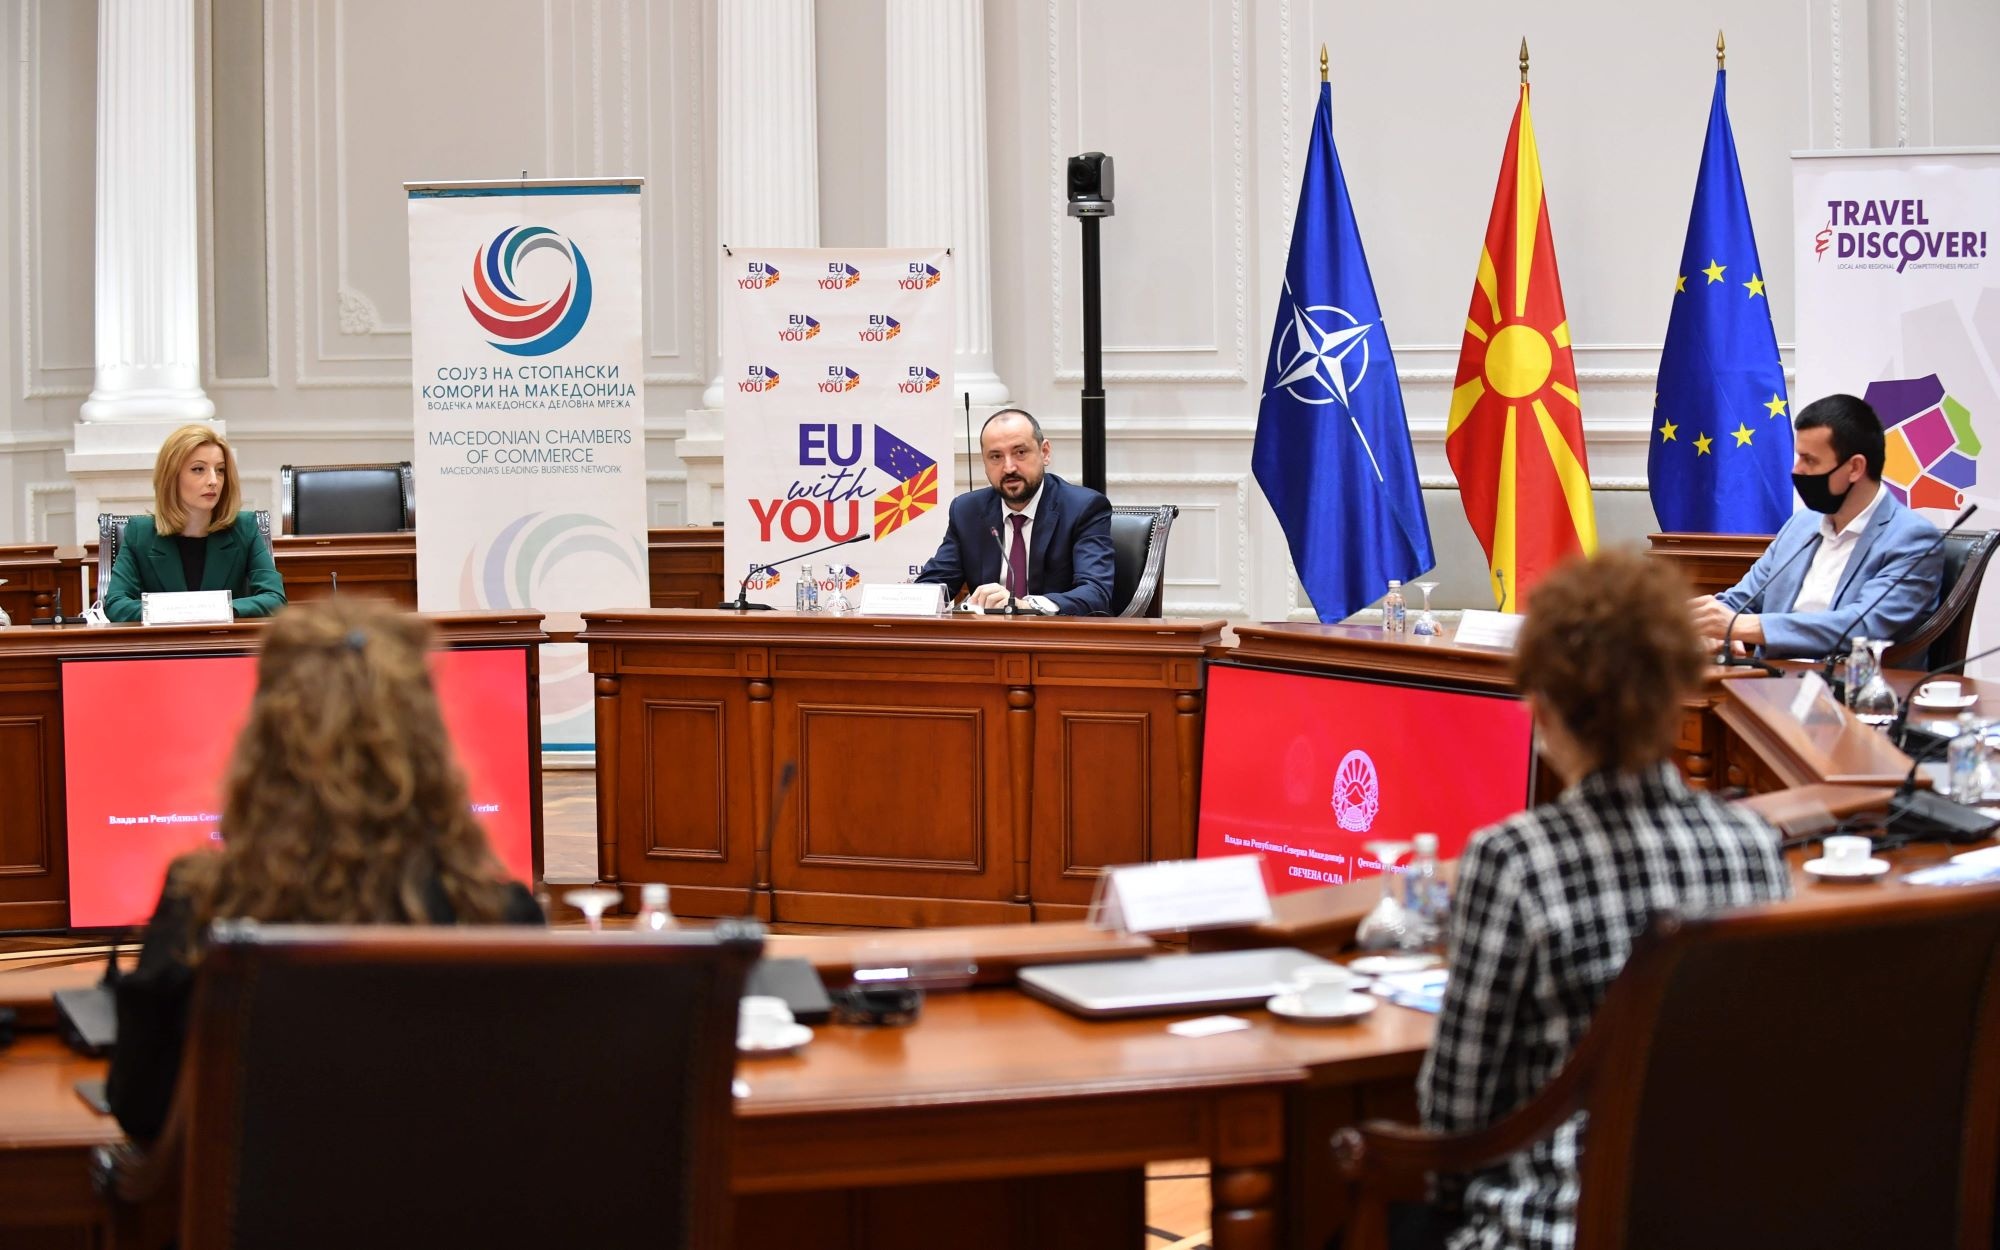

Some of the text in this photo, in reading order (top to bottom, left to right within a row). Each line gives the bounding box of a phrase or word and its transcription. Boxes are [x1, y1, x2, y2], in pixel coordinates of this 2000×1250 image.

[1828, 200, 1929, 226] TRAVEL
[1838, 230, 1987, 274] DISCOVER!
[749, 263, 763, 273] EU
[829, 263, 843, 273] EU
[909, 263, 924, 273] EU
[738, 280, 762, 289] YOU
[818, 280, 843, 289] YOU
[899, 280, 923, 289] YOU
[790, 315, 804, 325] EU
[870, 315, 884, 325] EU
[779, 332, 803, 341] YOU
[859, 332, 883, 341] YOU
[438, 366, 619, 380] СОЈУЗ НА СТОПАНСКИ
[749, 366, 763, 376] EU
[829, 366, 843, 376] EU
[909, 366, 923, 376] EU
[423, 383, 636, 399] КОМОРИ НА МАКЕДОНИЈА
[738, 383, 762, 393] YOU
[818, 383, 843, 393] YOU
[898, 383, 923, 393] YOU
[428, 400, 631, 411] ВОДЕЧКА МАКЕДОНСКА ДЕЛОВНА МРЕЖА
[429, 429, 632, 445] MACEDONIAN CHAMBERS
[800, 424, 862, 466] EU
[467, 448, 593, 464] OF COMMERCE
[441, 465, 622, 475] MACEDONIA'S LEADING BUSINESS NETWORK
[788, 468, 876, 503] with
[748, 499, 859, 544] YOU
[109, 816, 136, 826] Влада
[1289, 866, 1343, 885] СВЕЧЕНА САЛА
